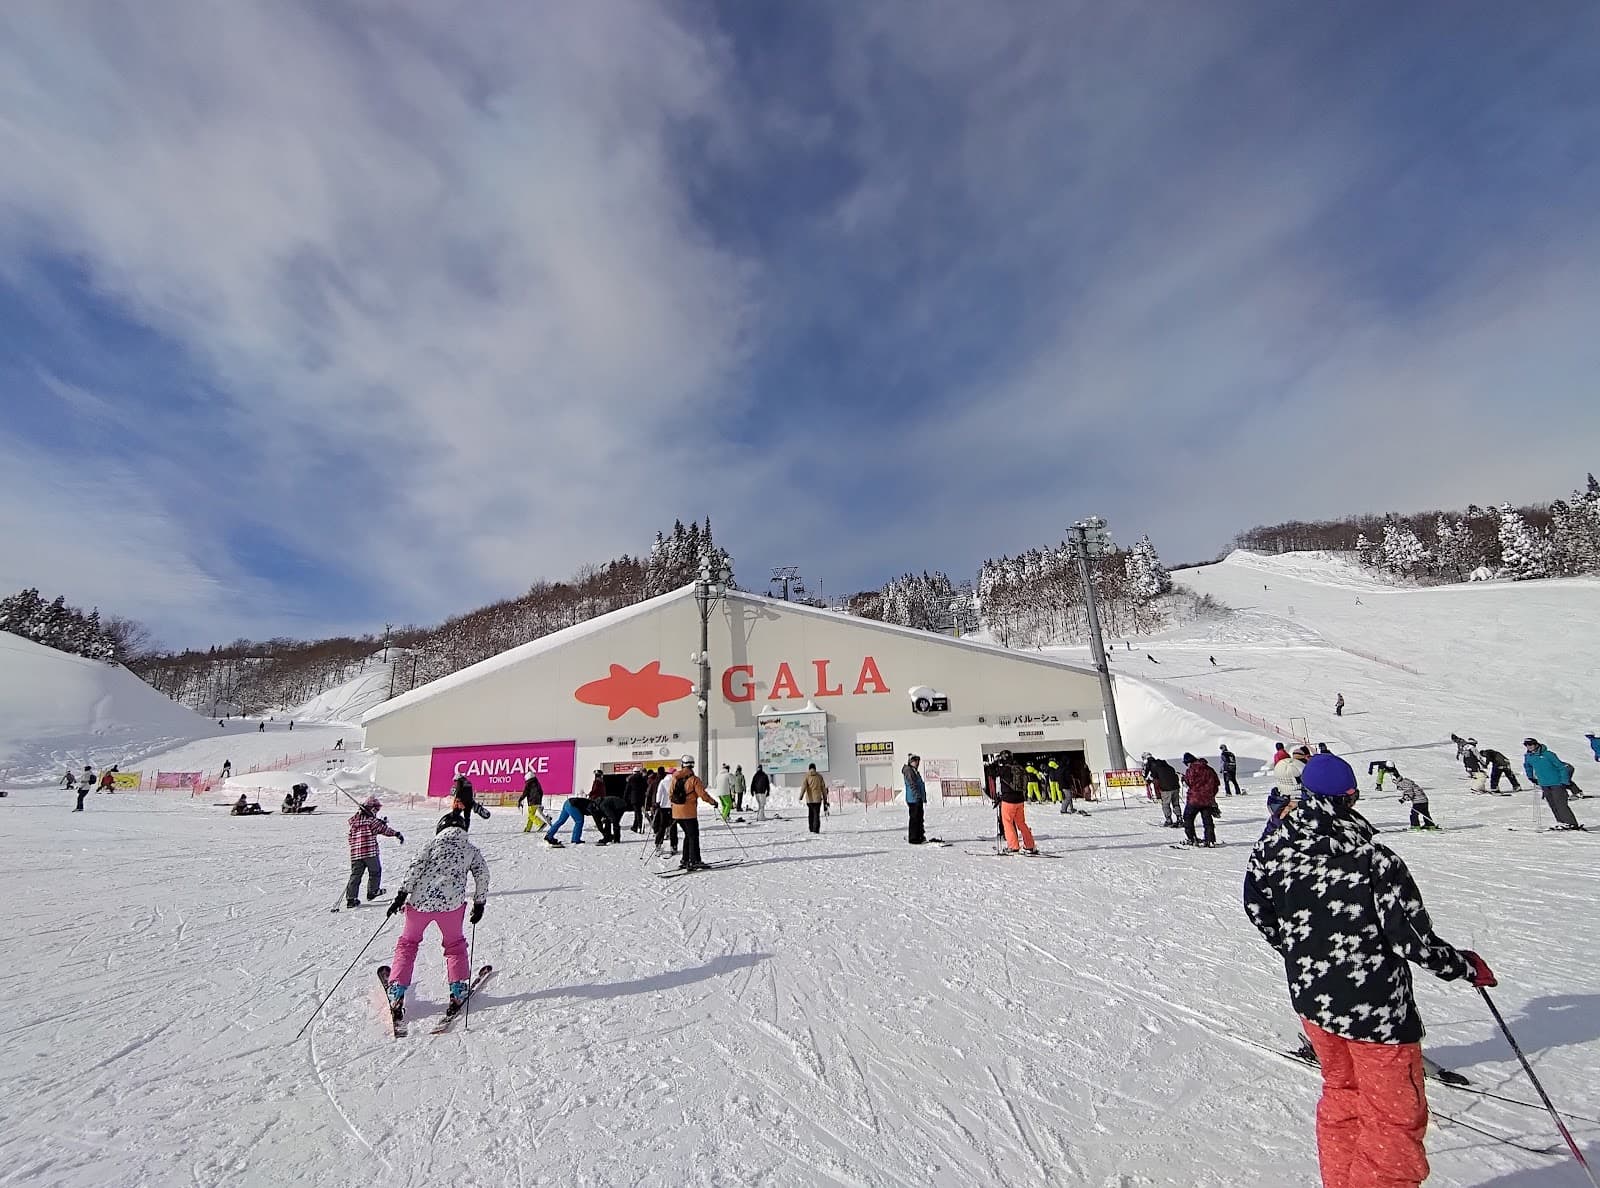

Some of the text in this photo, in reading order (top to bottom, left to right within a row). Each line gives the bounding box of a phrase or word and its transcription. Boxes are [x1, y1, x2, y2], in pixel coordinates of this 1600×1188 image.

[722, 656, 890, 703] GALA
[1013, 714, 1059, 724] バルーシュ
[630, 734, 669, 745] ソーシャブル
[454, 757, 550, 777] CANMAKE
[489, 776, 512, 784] TOKYO
